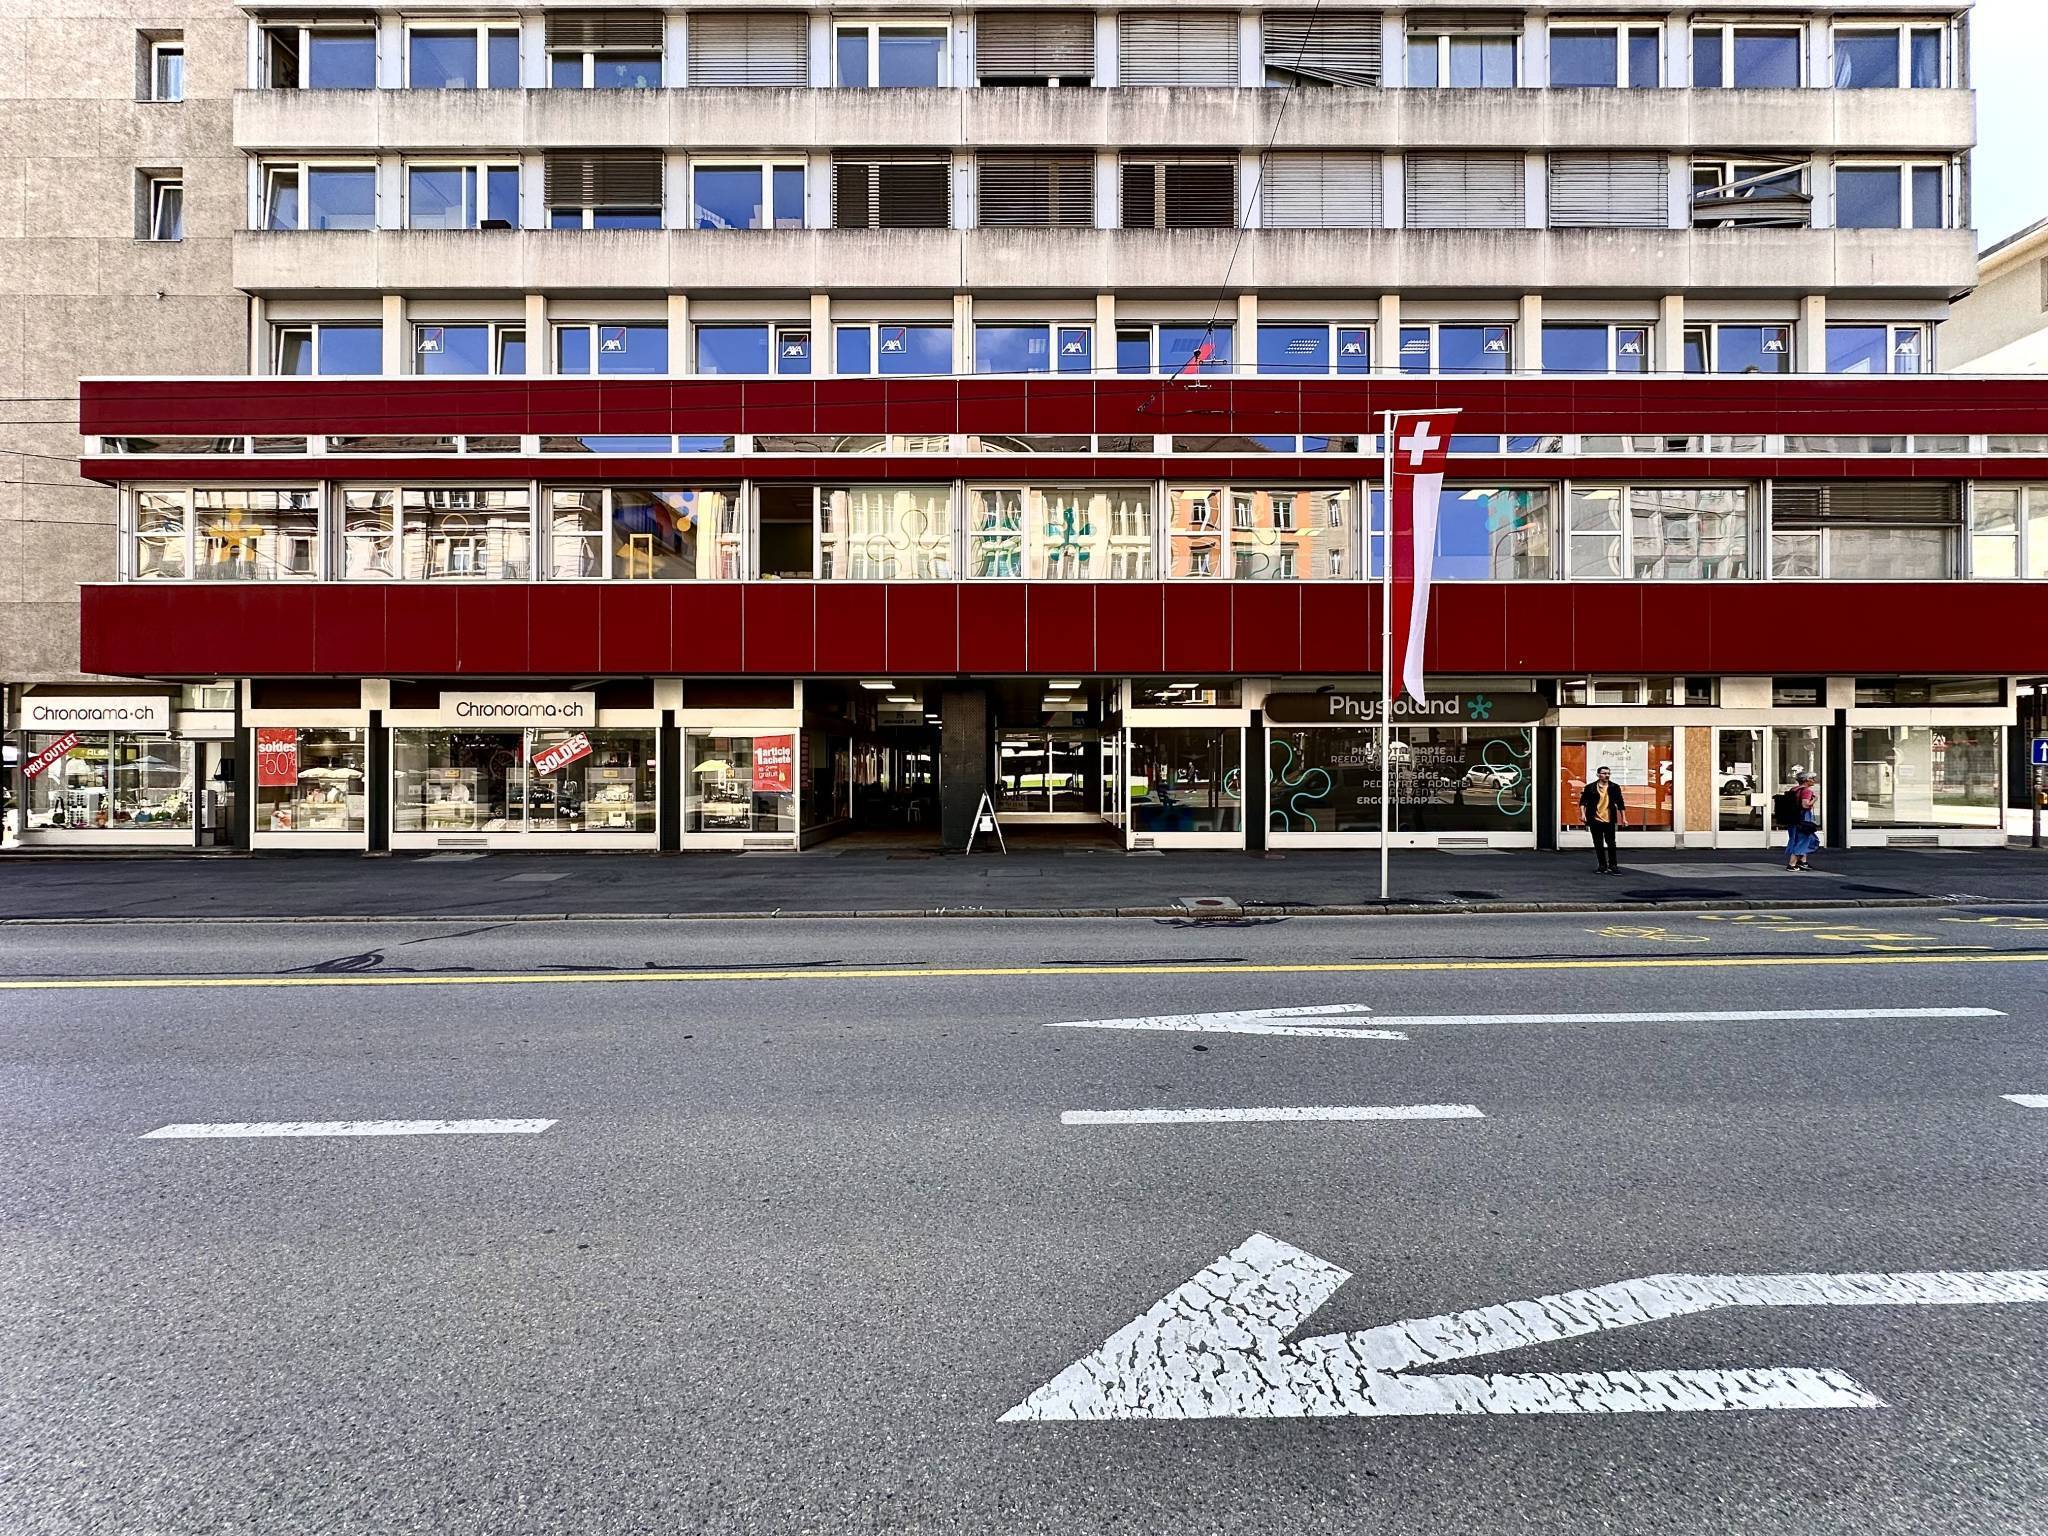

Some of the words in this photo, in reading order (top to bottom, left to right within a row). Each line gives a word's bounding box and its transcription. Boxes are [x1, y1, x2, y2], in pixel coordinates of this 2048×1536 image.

[418, 339, 439, 350] AXA
[601, 339, 622, 350] AXA
[783, 345, 803, 355] AXA
[881, 339, 902, 350] AXA
[1062, 342, 1082, 353] AXA
[1341, 343, 1361, 353] AXA
[1484, 340, 1505, 350] AXA
[1620, 342, 1640, 353] AXA
[1763, 340, 1783, 350] AXA
[1330, 695, 1459, 720] Physoland
[258, 741, 296, 752] soldes
[763, 747, 790, 756] article
[24, 757, 46, 777] PRIX
[44, 733, 77, 762] OUTLET
[536, 733, 590, 775] SOLDES
